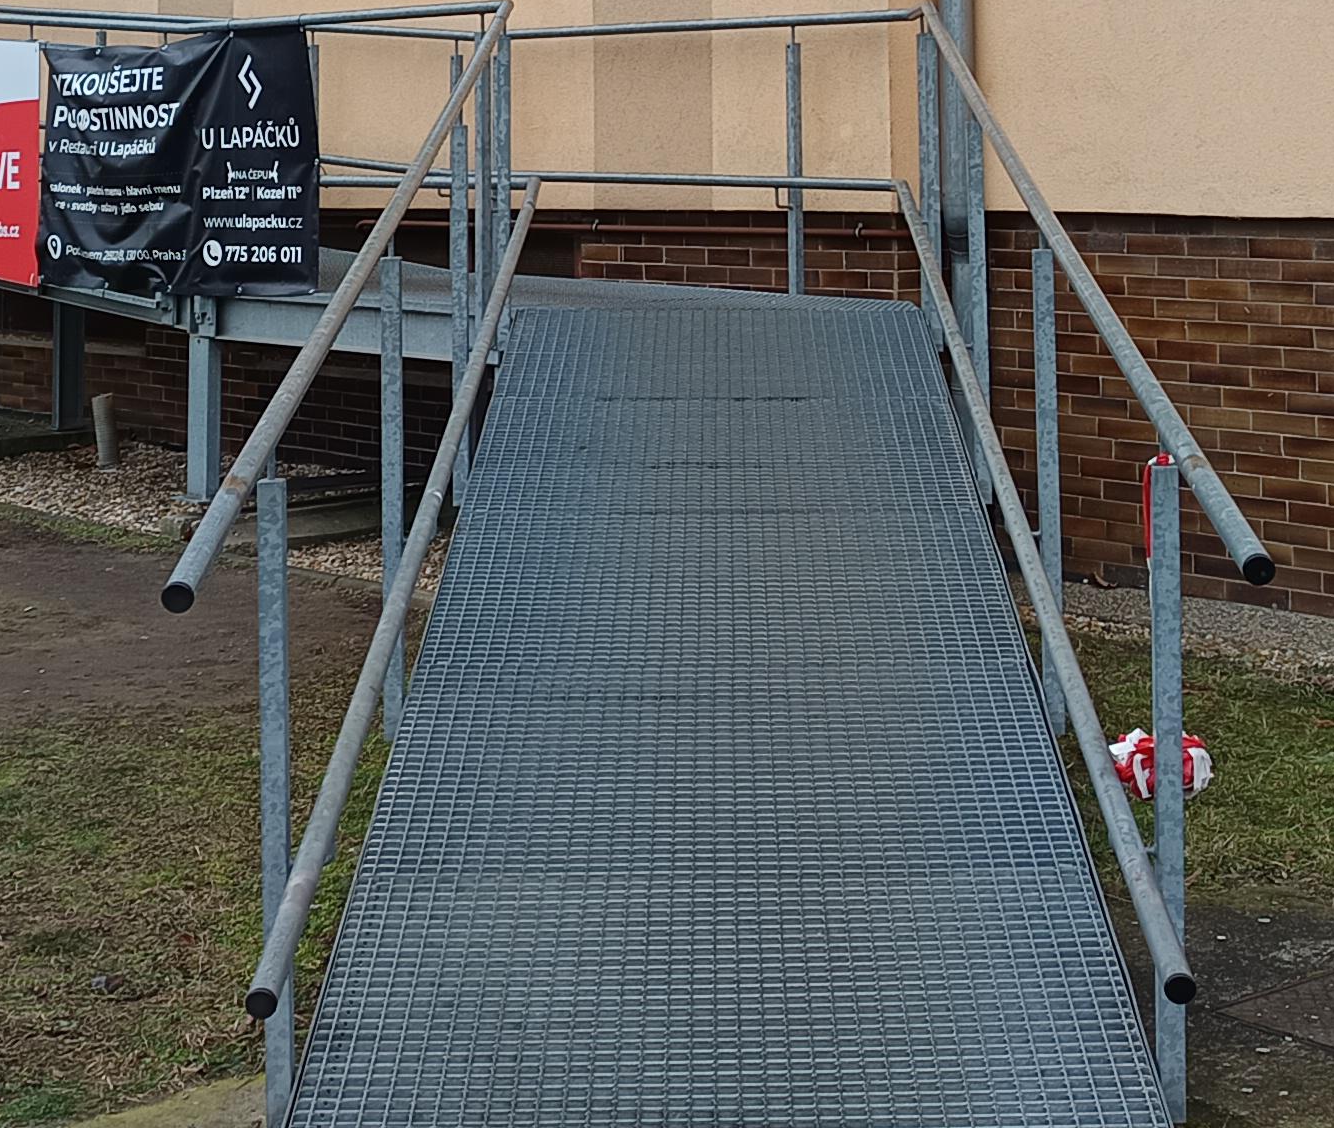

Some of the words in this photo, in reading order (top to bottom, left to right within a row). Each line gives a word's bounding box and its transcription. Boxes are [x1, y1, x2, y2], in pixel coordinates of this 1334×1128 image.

[52, 65, 164, 96] VZKOUŠEJTE
[201, 127, 215, 150] U
[220, 117, 300, 149] LAPÁČKŮ
[49, 140, 58, 153] v
[99, 141, 109, 157] U
[110, 136, 157, 159] Lapáčků
[235, 170, 247, 180] NA
[247, 168, 269, 180] ČEPU
[50, 182, 82, 194] salonek
[153, 184, 181, 194] menu
[202, 185, 234, 200] Plzeň
[256, 185, 286, 200] Kozel
[70, 201, 98, 215] svatby
[203, 213, 303, 232] www.ulapacku.cz
[153, 249, 181, 261] Praha
[225, 245, 248, 262] 775
[251, 245, 277, 263] 206
[280, 246, 302, 263] 011
